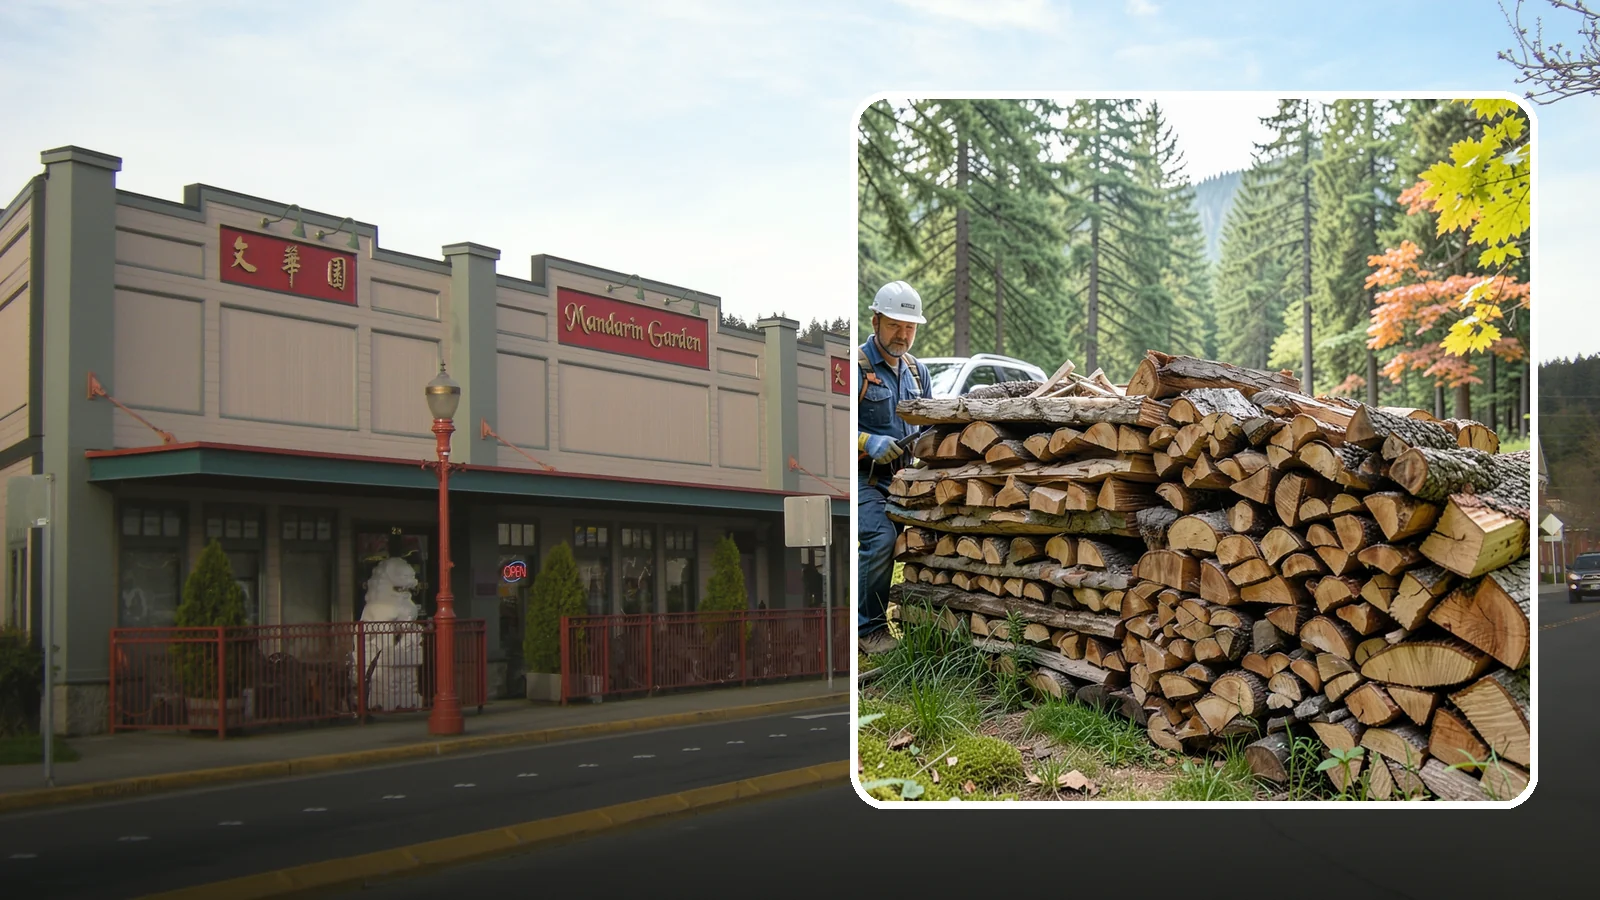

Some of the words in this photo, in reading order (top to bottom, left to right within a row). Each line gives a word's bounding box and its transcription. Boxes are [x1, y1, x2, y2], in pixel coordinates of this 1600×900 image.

[230, 235, 346, 291] 文華園
[564, 302, 644, 341] Mandarin
[647, 320, 702, 352] Garden
[503, 565, 527, 578] OPEN
